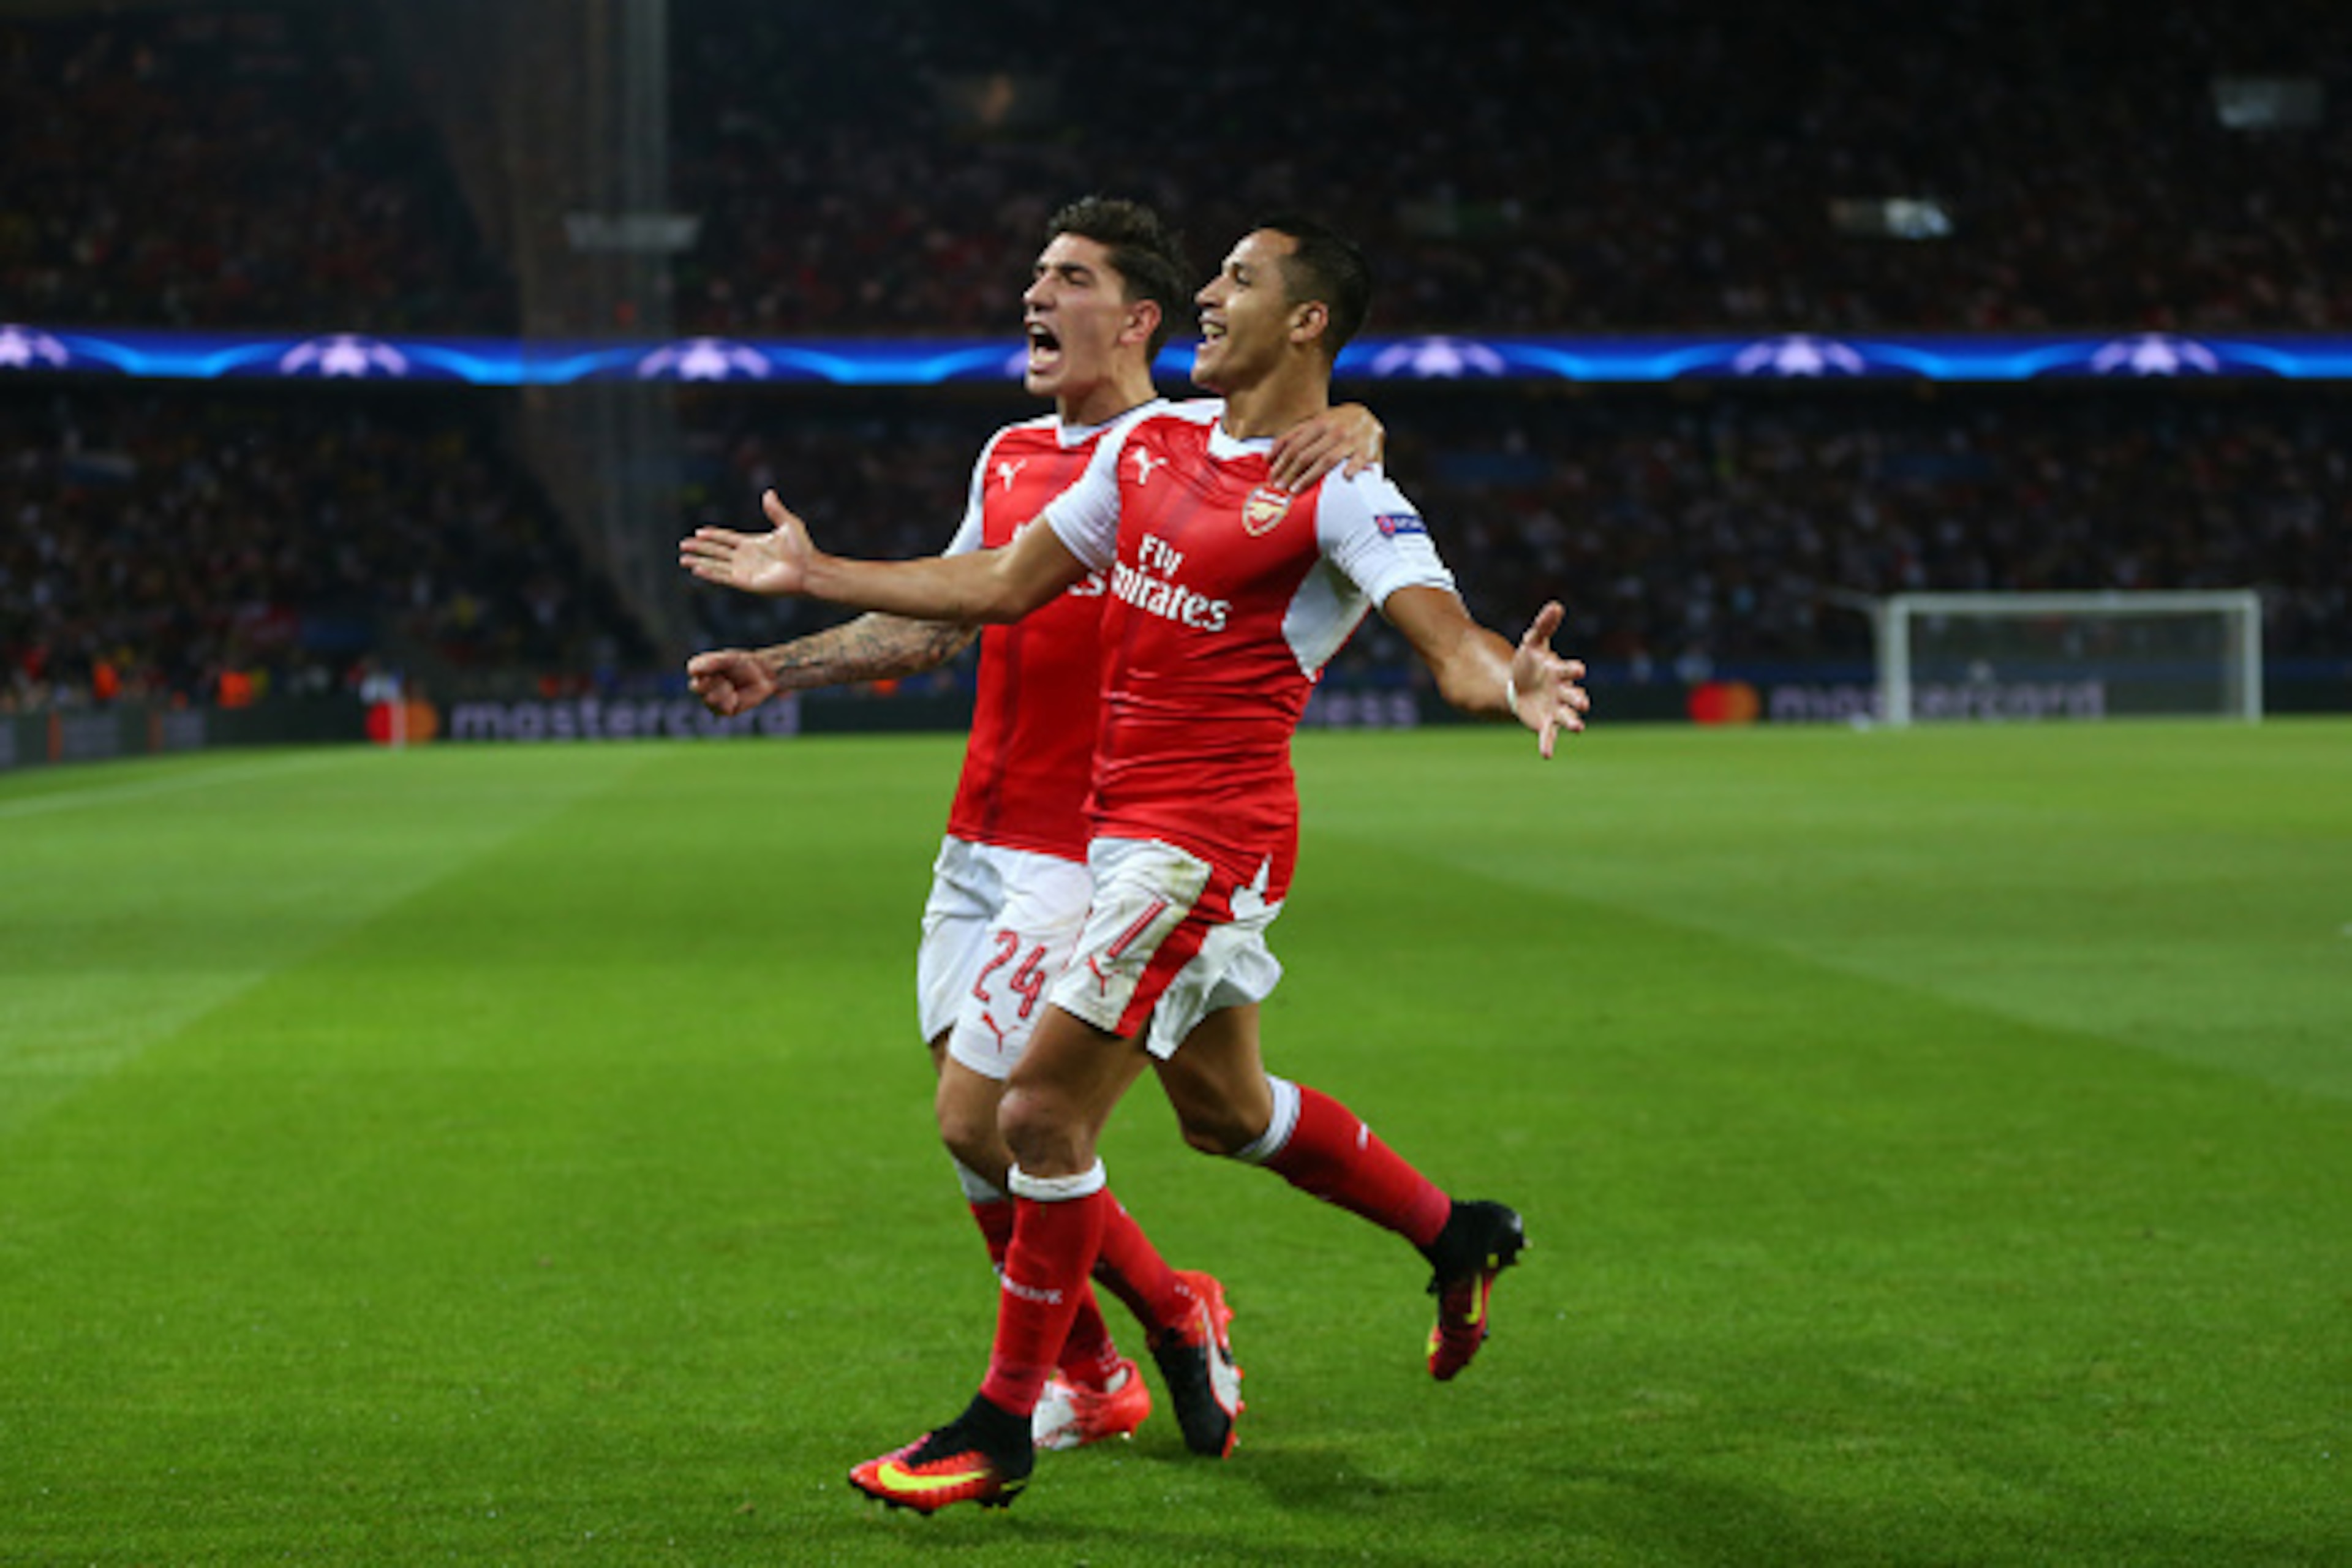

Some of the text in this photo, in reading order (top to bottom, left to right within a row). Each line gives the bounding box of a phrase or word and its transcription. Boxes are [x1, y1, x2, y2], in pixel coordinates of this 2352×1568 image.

[1138, 533, 1185, 578] Fly
[1110, 560, 1232, 632] mirates
[971, 928, 1047, 1019] 24
